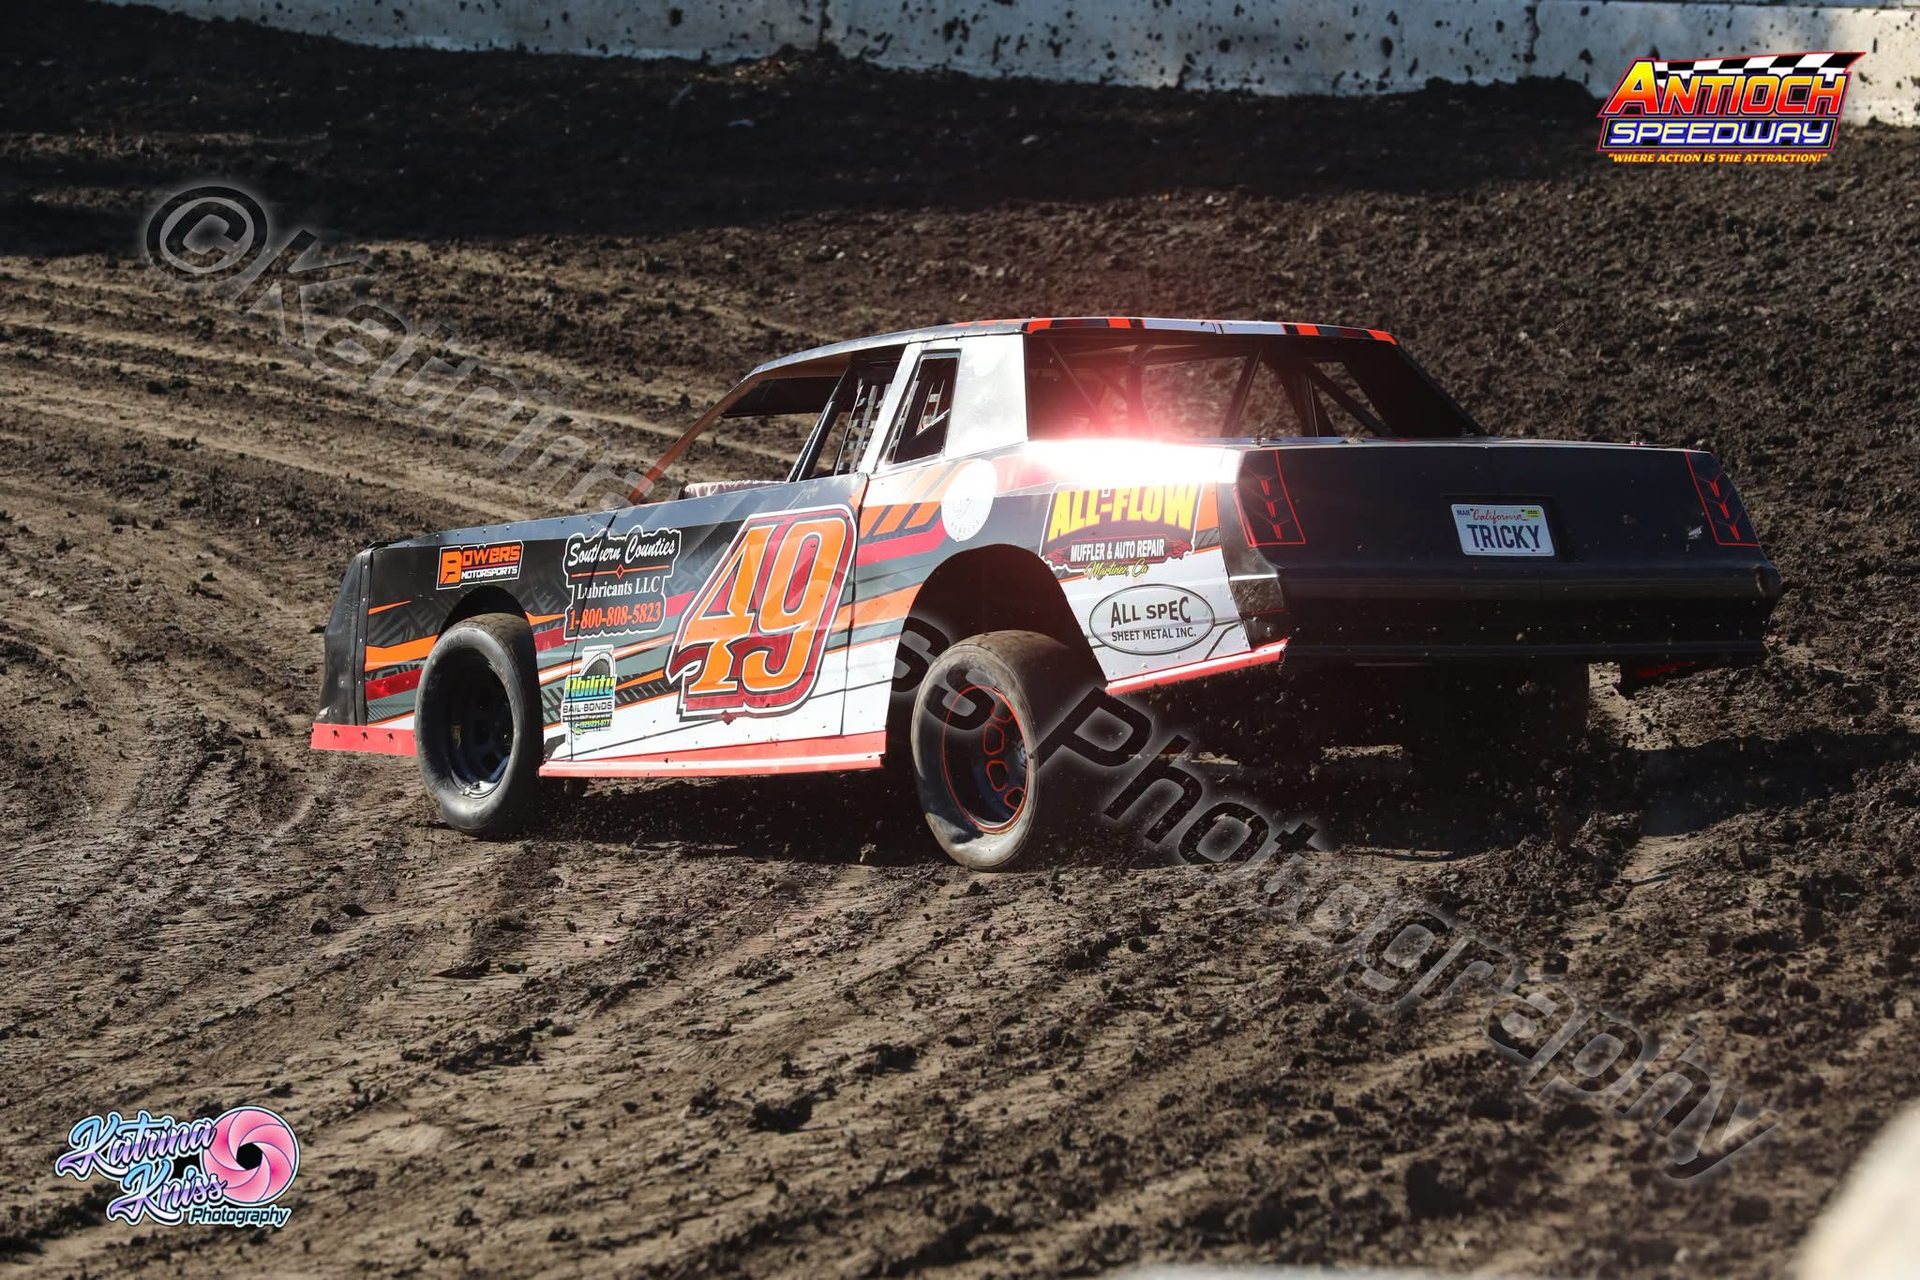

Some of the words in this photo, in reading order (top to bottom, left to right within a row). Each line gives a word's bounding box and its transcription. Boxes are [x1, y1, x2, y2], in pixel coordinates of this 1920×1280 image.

[1048, 484, 1199, 542] ALL-FLOW
[1472, 508, 1522, 523] California
[1466, 523, 1541, 549] TRICKY
[568, 539, 622, 567] Southern
[625, 535, 675, 564] Counties
[1070, 543, 1106, 562] MUFFLER
[1107, 542, 1113, 559] &
[1114, 541, 1136, 560] AUTO
[1137, 538, 1165, 558] REPAIR
[440, 545, 521, 585] BOWERS
[461, 565, 519, 580] MOTORSPORTS
[577, 579, 633, 600] Lubricants
[635, 575, 661, 594] LLC
[568, 601, 661, 630] 1-800-808-5823
[670, 508, 853, 708] 49
[1111, 601, 1142, 628] ALL
[1146, 596, 1192, 624] SPEC
[1111, 630, 1141, 642] SHEET
[1142, 628, 1174, 640] METAL
[1176, 626, 1197, 638] INC.
[565, 675, 615, 698] Ability
